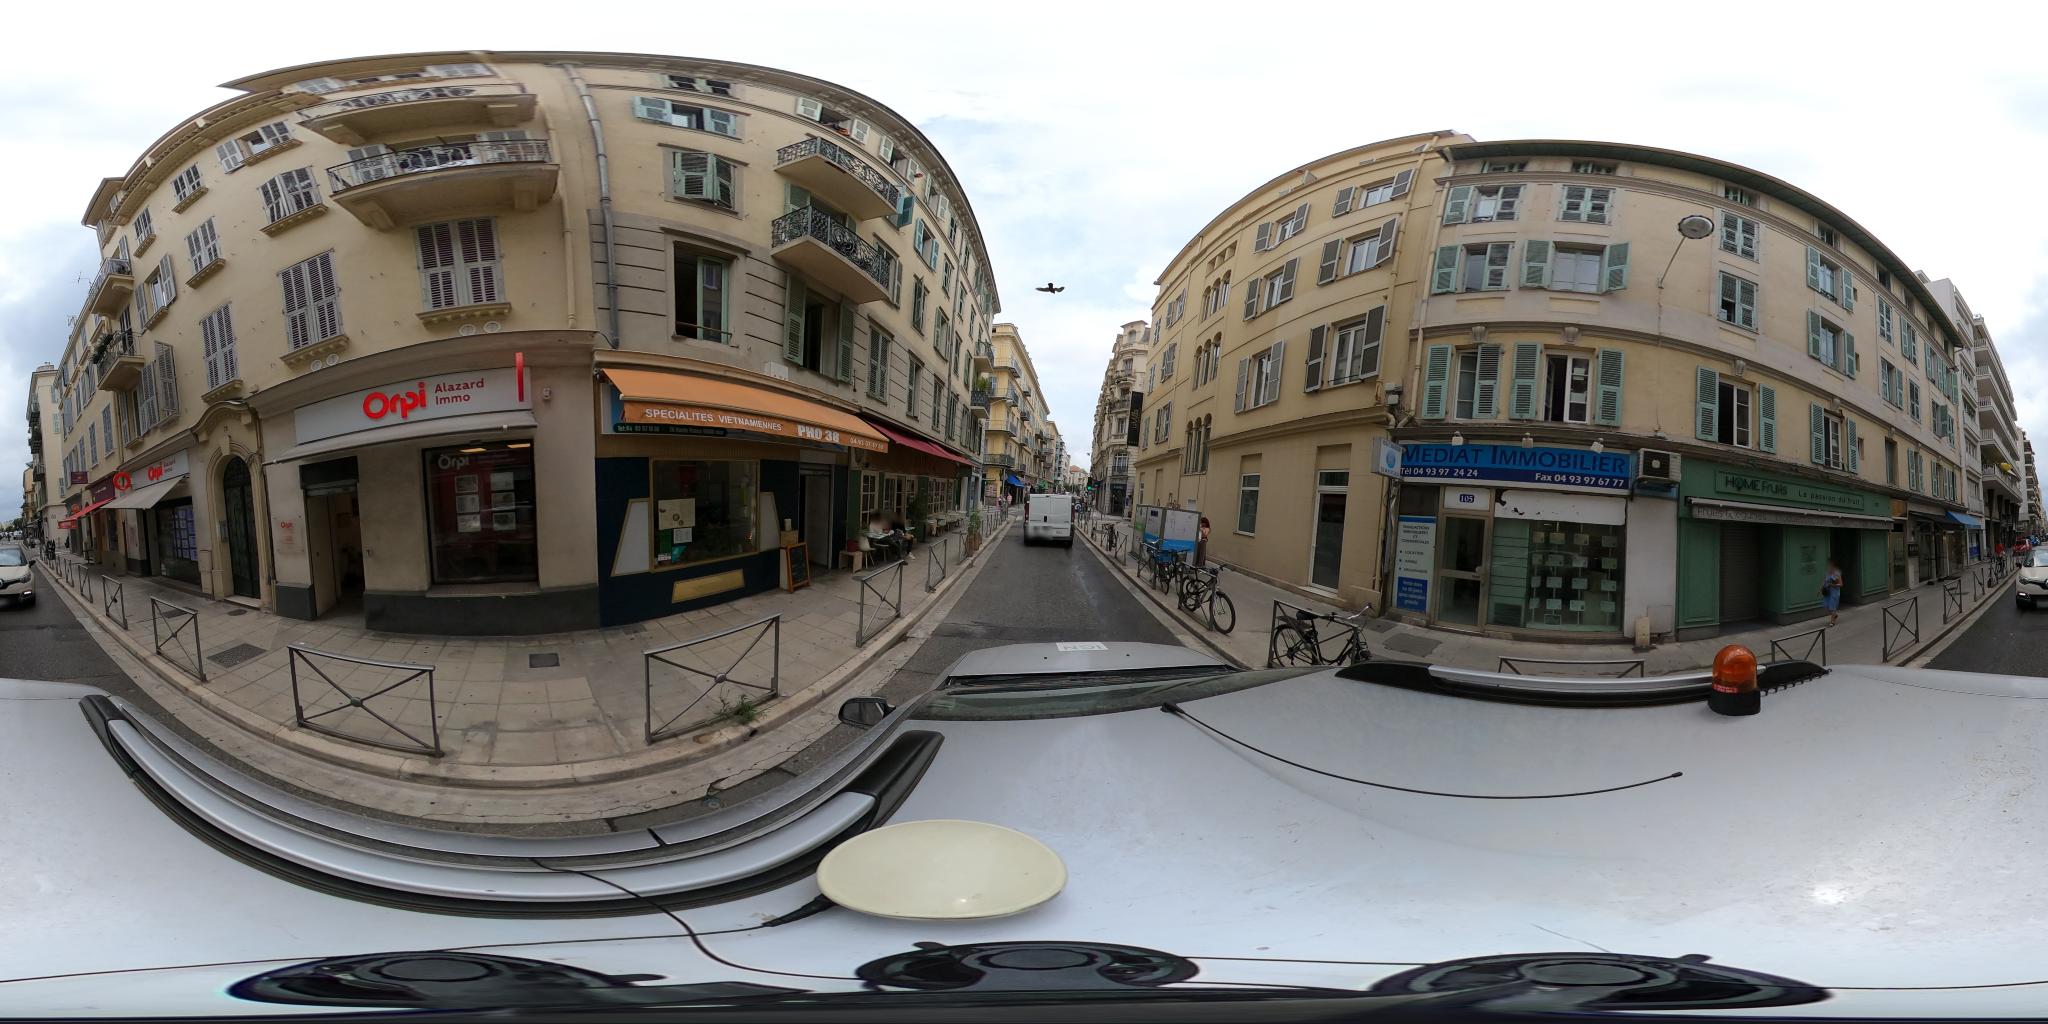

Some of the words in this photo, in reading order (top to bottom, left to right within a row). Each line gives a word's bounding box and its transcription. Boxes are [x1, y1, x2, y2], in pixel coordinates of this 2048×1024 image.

[363, 382, 427, 419] Orpi
[434, 378, 485, 393] Alazard
[435, 393, 470, 405] Immo
[645, 408, 714, 422] SPECIALITES
[718, 415, 782, 431] VIETNAMIENNES
[797, 424, 822, 440] PHO
[825, 430, 840, 443] 38
[438, 455, 469, 470] Orpi
[1403, 445, 1483, 463] MEDIAT
[1491, 445, 1625, 473] IMMOBILIER
[1413, 467, 1424, 475] 04
[1467, 469, 1478, 477] 24
[1535, 472, 1552, 481] Fax
[1554, 474, 1566, 482] 04
[1569, 475, 1581, 483] 93
[1584, 476, 1594, 485] 97
[1598, 478, 1610, 486] 67
[1612, 478, 1624, 487] 77
[1725, 475, 1760, 491] HOME
[1461, 495, 1473, 503] 105
